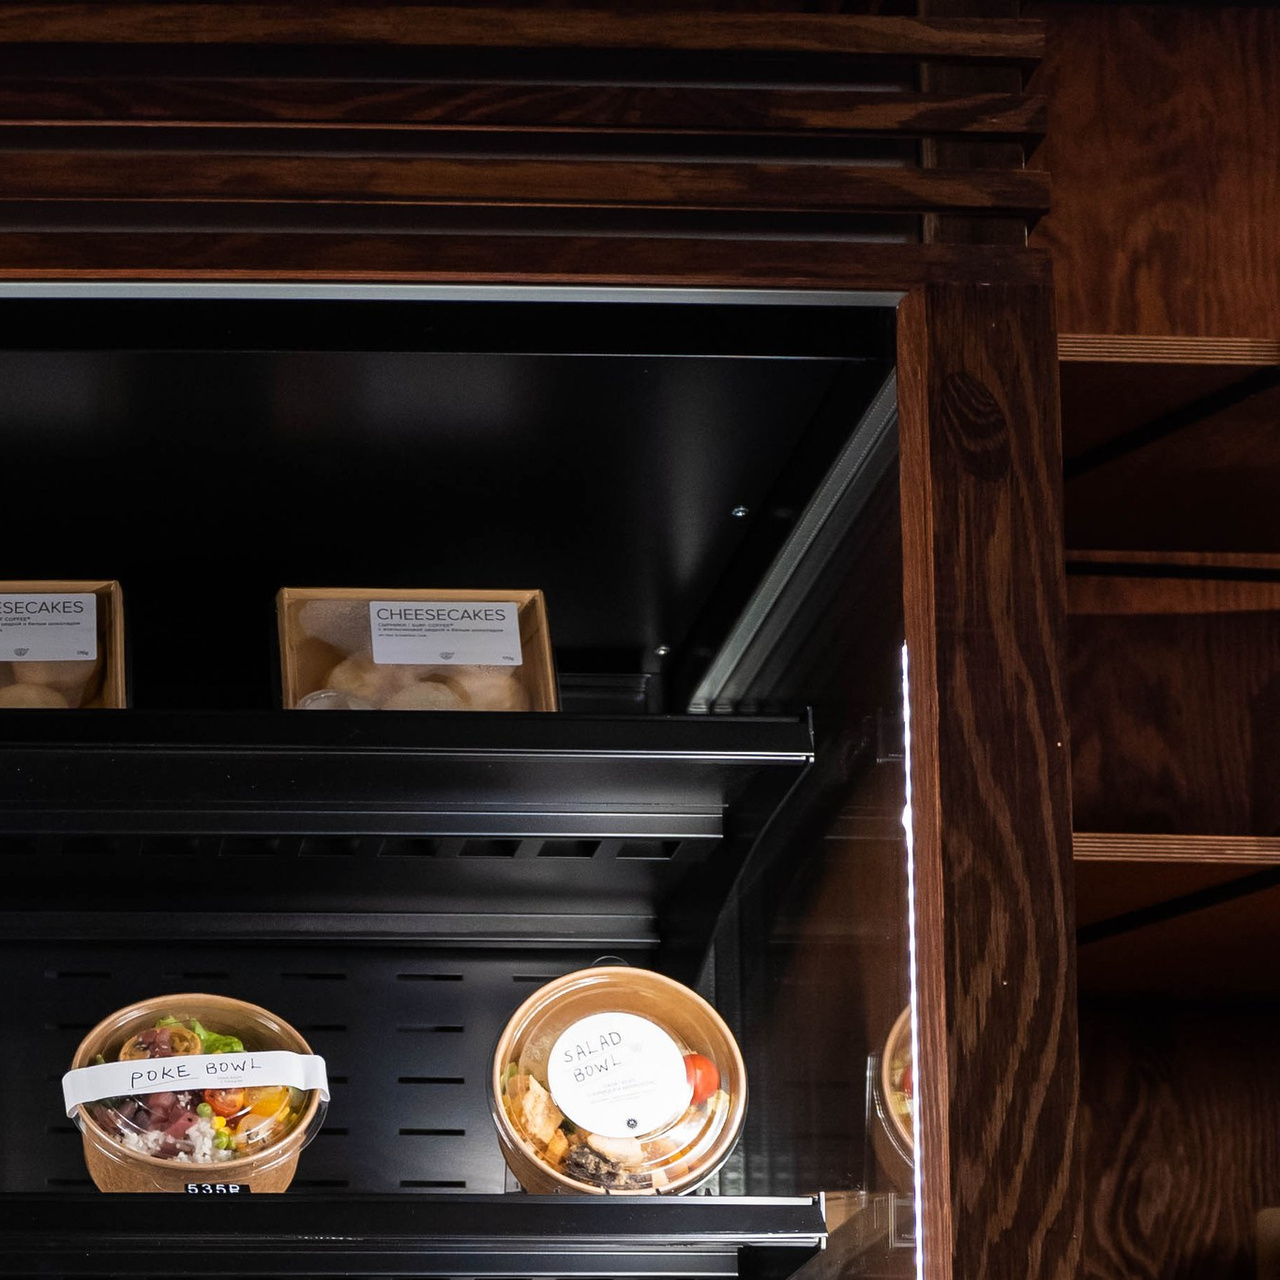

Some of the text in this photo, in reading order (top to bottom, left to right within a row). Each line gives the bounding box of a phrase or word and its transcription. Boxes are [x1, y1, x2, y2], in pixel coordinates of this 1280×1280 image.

[376, 608, 506, 621] CHEESECAKES
[563, 1031, 622, 1064] SALAD
[130, 1058, 262, 1088] POKE BOWL
[573, 1058, 622, 1083] BOWL
